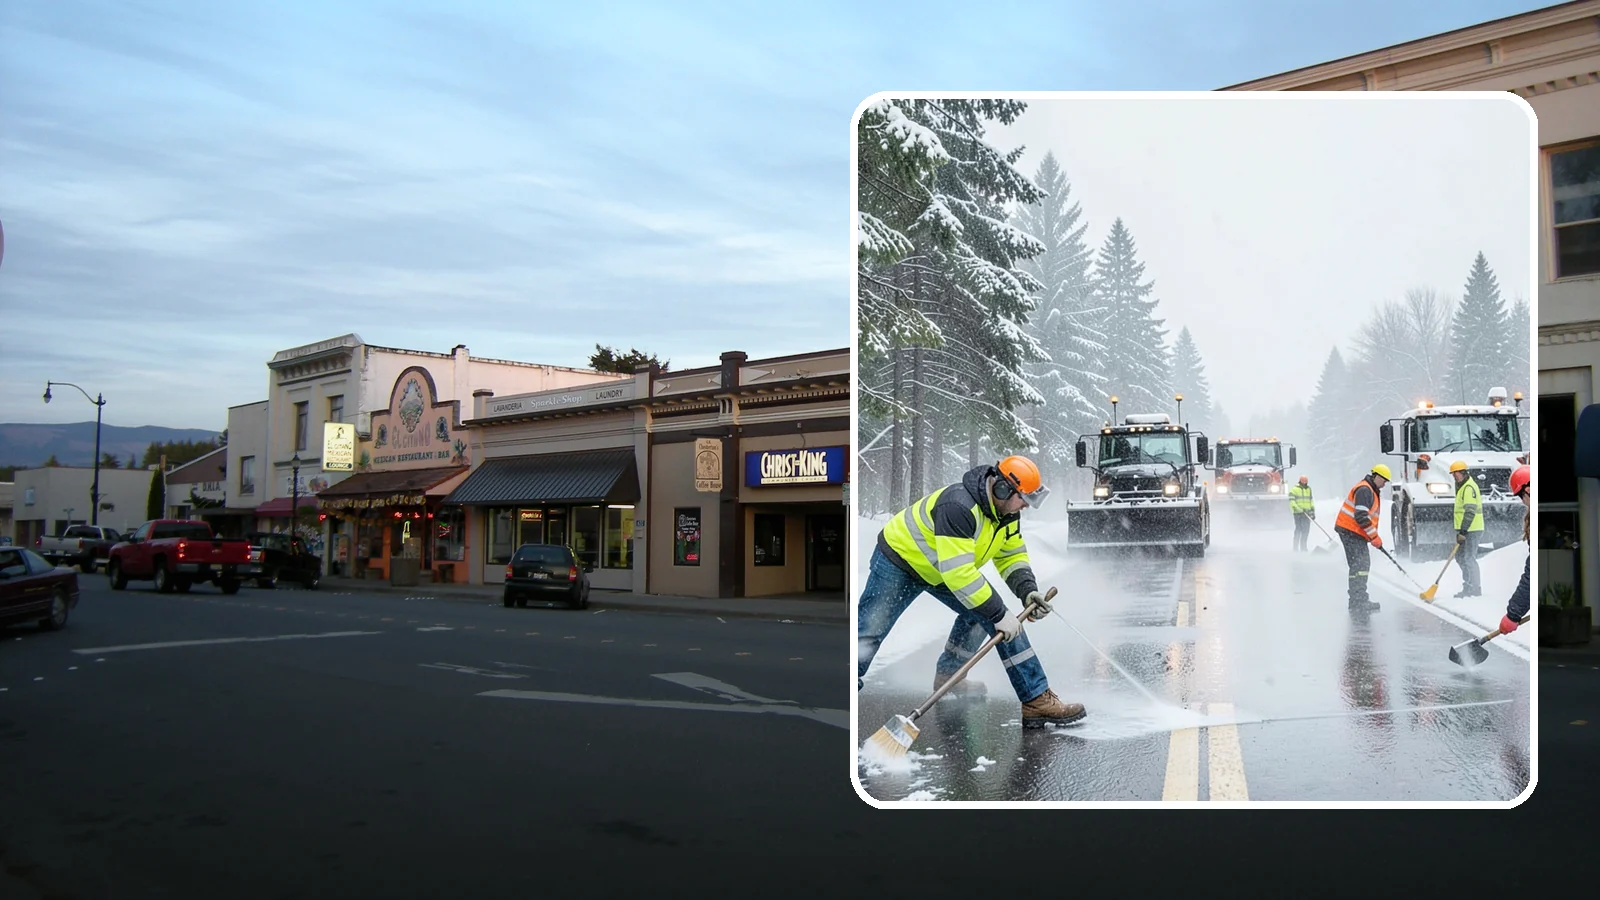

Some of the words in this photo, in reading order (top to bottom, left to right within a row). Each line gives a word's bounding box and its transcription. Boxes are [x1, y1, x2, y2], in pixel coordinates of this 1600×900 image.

[595, 389, 624, 400] LAUNDRY
[530, 396, 561, 409] Sparkle
[562, 394, 582, 406] Shop
[493, 402, 523, 413] LAVANDERIA
[397, 451, 433, 462] RESTAURANT
[437, 450, 450, 459] BAR
